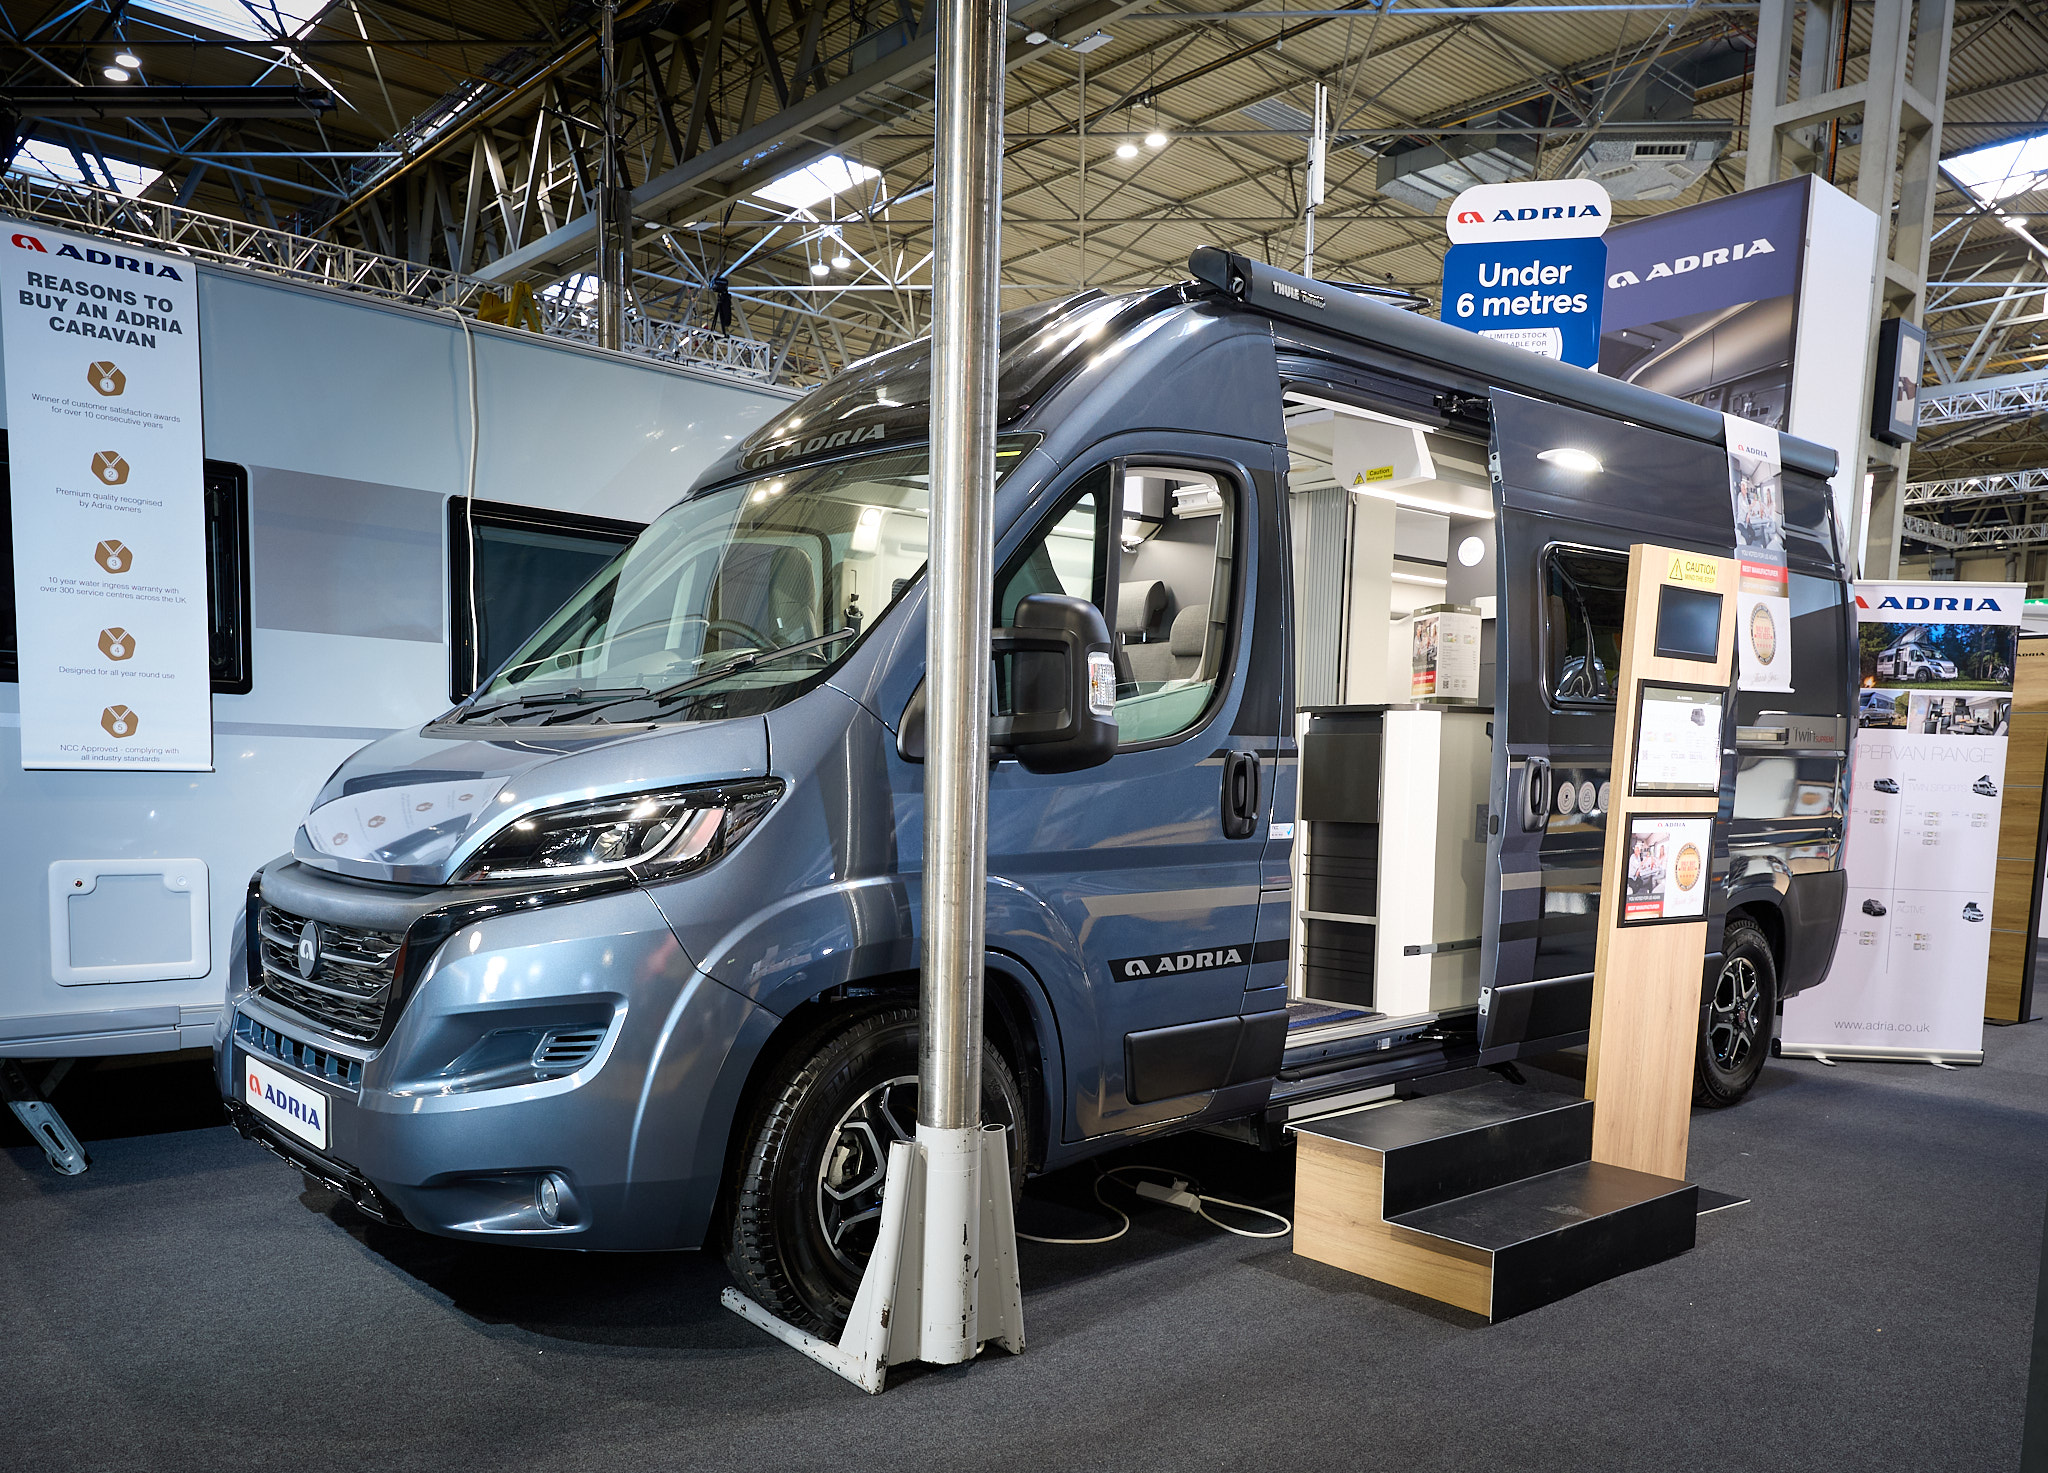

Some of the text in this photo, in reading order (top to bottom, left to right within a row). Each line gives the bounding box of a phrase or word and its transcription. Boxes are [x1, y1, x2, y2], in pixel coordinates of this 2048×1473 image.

[1492, 204, 1602, 224] ADRIA
[56, 243, 183, 282] ADRIA
[1645, 238, 1776, 281] ADRIA
[1478, 259, 1573, 287] Under
[27, 271, 173, 312] REASONS TO
[1273, 281, 1300, 301] THULE
[19, 290, 183, 335] BUY AN ADRIA
[1456, 290, 1588, 317] 6 metres
[49, 316, 156, 349] CARAVAN
[31, 393, 60, 404] Winner
[71, 401, 108, 411] customer
[109, 406, 152, 418] satisfaction
[153, 413, 181, 423] awards
[51, 406, 63, 414] for
[83, 410, 94, 419] 10
[95, 413, 141, 426] consecutive
[142, 420, 164, 430] years
[780, 423, 885, 460] ADRIA
[1746, 446, 1768, 457] ADRIA
[55, 487, 163, 507] Premium quality recognised
[79, 500, 142, 514] by Adria owners
[1685, 561, 1716, 575] CAUTION
[39, 585, 187, 604] over 300 service centres across the UK
[49, 576, 179, 595] 10 year water ingress warranty with
[1877, 596, 2002, 612] ADRIA
[58, 665, 96, 675] Designed
[120, 670, 137, 678] year
[138, 671, 160, 679] round
[1793, 727, 1816, 742] Twin
[60, 744, 79, 752] NCC
[81, 745, 118, 754] Approved
[125, 746, 163, 755] complying
[91, 755, 121, 763] industry
[123, 755, 160, 763] standards
[1931, 746, 1996, 763] RANGE
[1908, 783, 1929, 792] TWIN
[1930, 784, 1968, 793] SPORTS
[1896, 905, 1926, 914] ACTIVE
[1156, 949, 1242, 974] ADRIA
[1834, 1020, 1931, 1033] www.adria.co.uk
[265, 1084, 321, 1131] ADRIA
